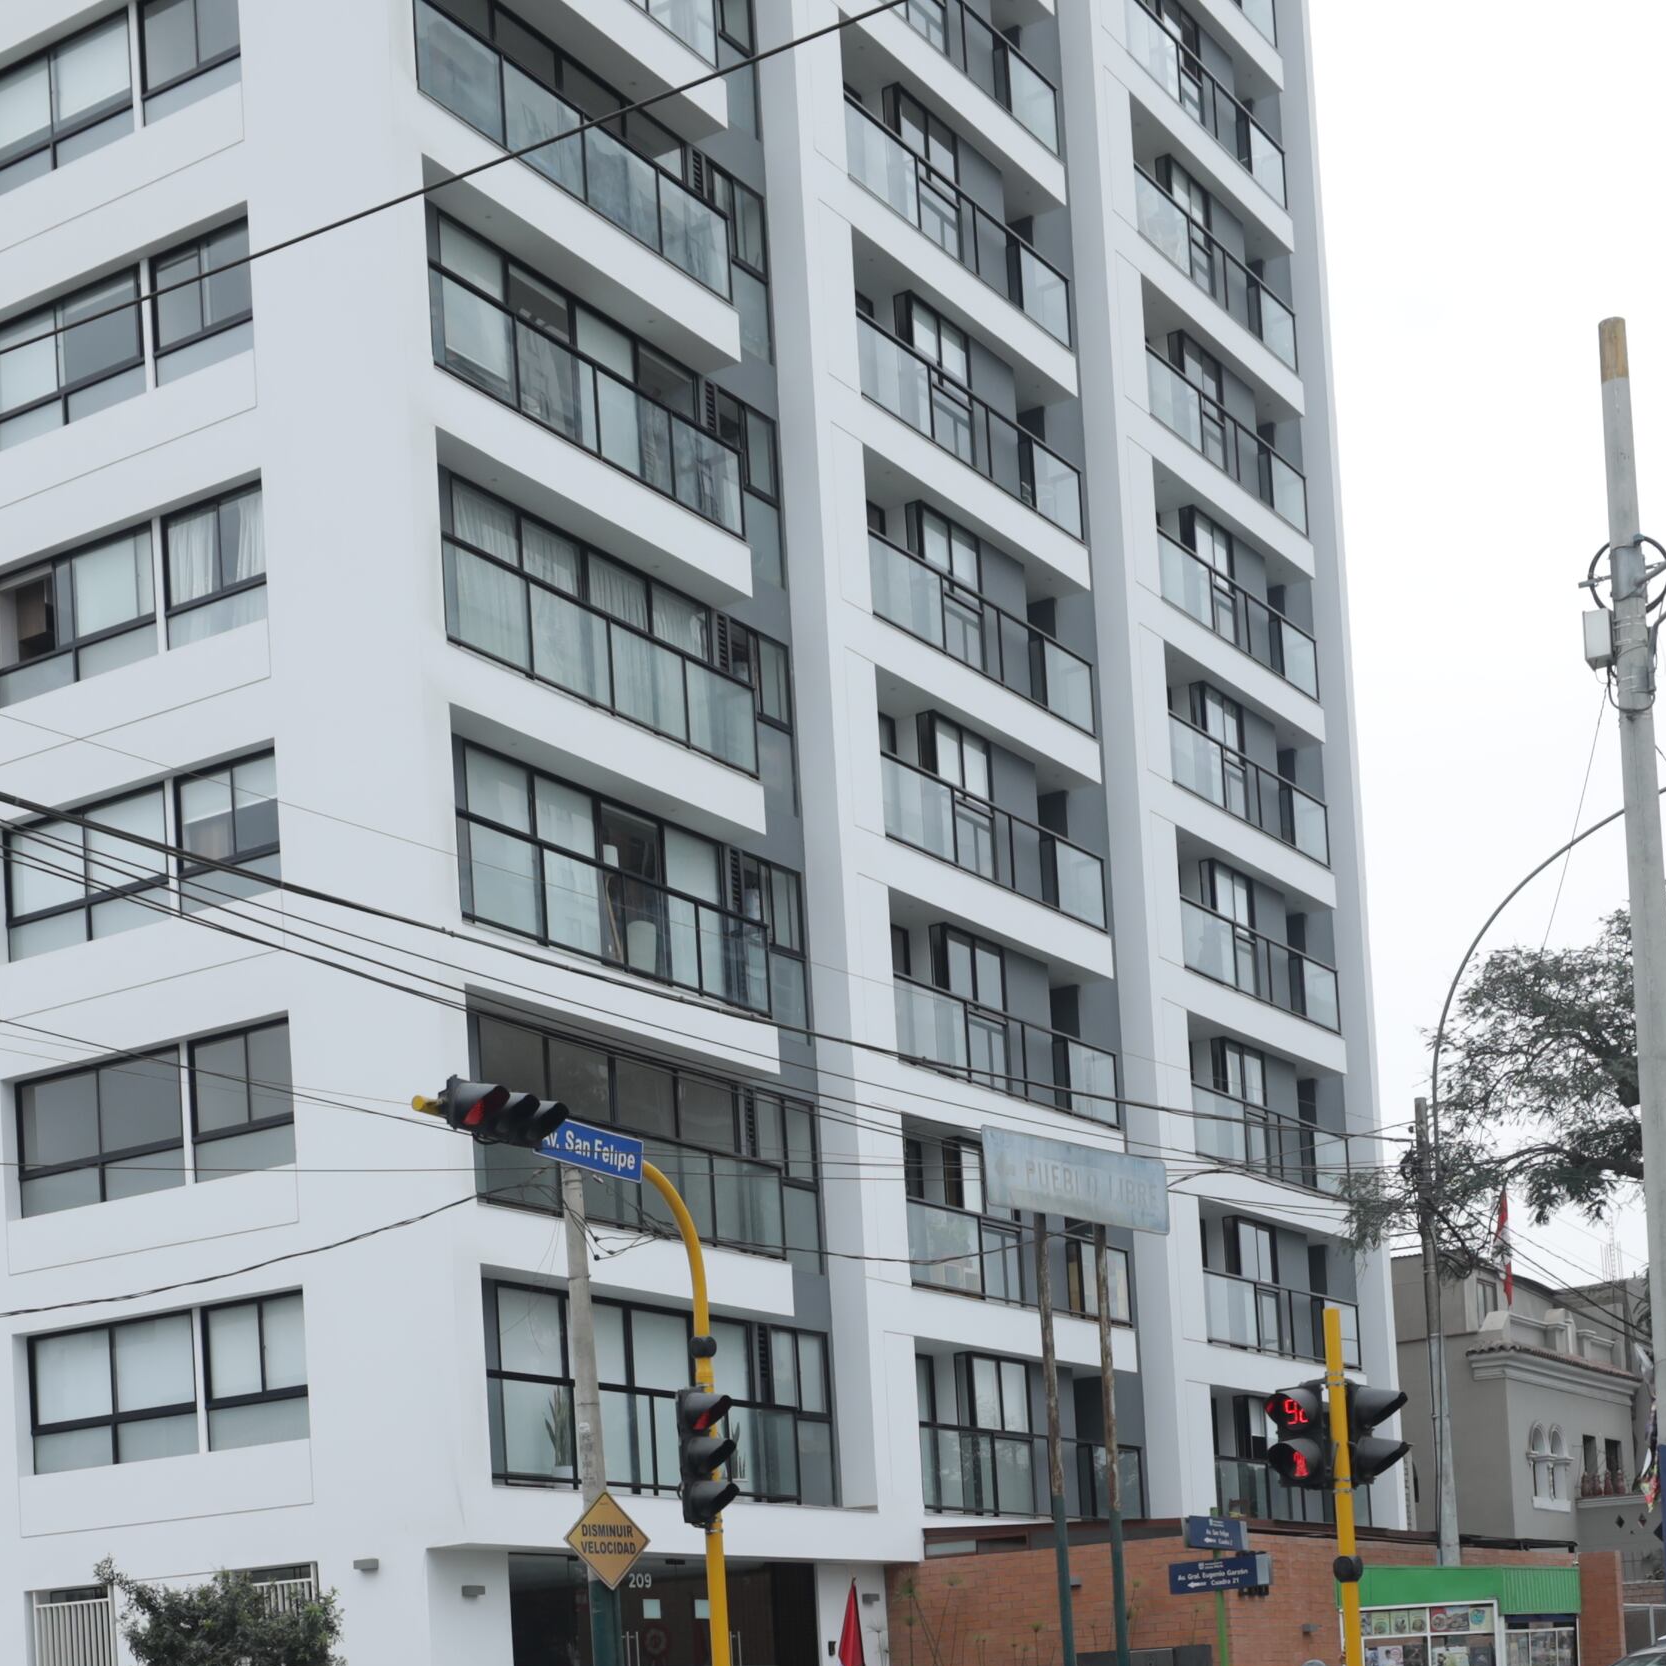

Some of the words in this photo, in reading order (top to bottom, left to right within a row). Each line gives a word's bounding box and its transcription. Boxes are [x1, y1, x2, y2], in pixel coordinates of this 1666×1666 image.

[565, 1130, 590, 1158] San
[594, 1139, 636, 1171] Felipe
[1025, 1159, 1098, 1197] PUEBLO
[1108, 1174, 1158, 1210] LIBRE
[581, 1524, 634, 1538] DISMINUIR
[580, 1541, 637, 1555] VELOCIDAD
[628, 1573, 652, 1588] 209
[1202, 1570, 1226, 1579] Eugenio
[1210, 1578, 1231, 1586] Cuadra
